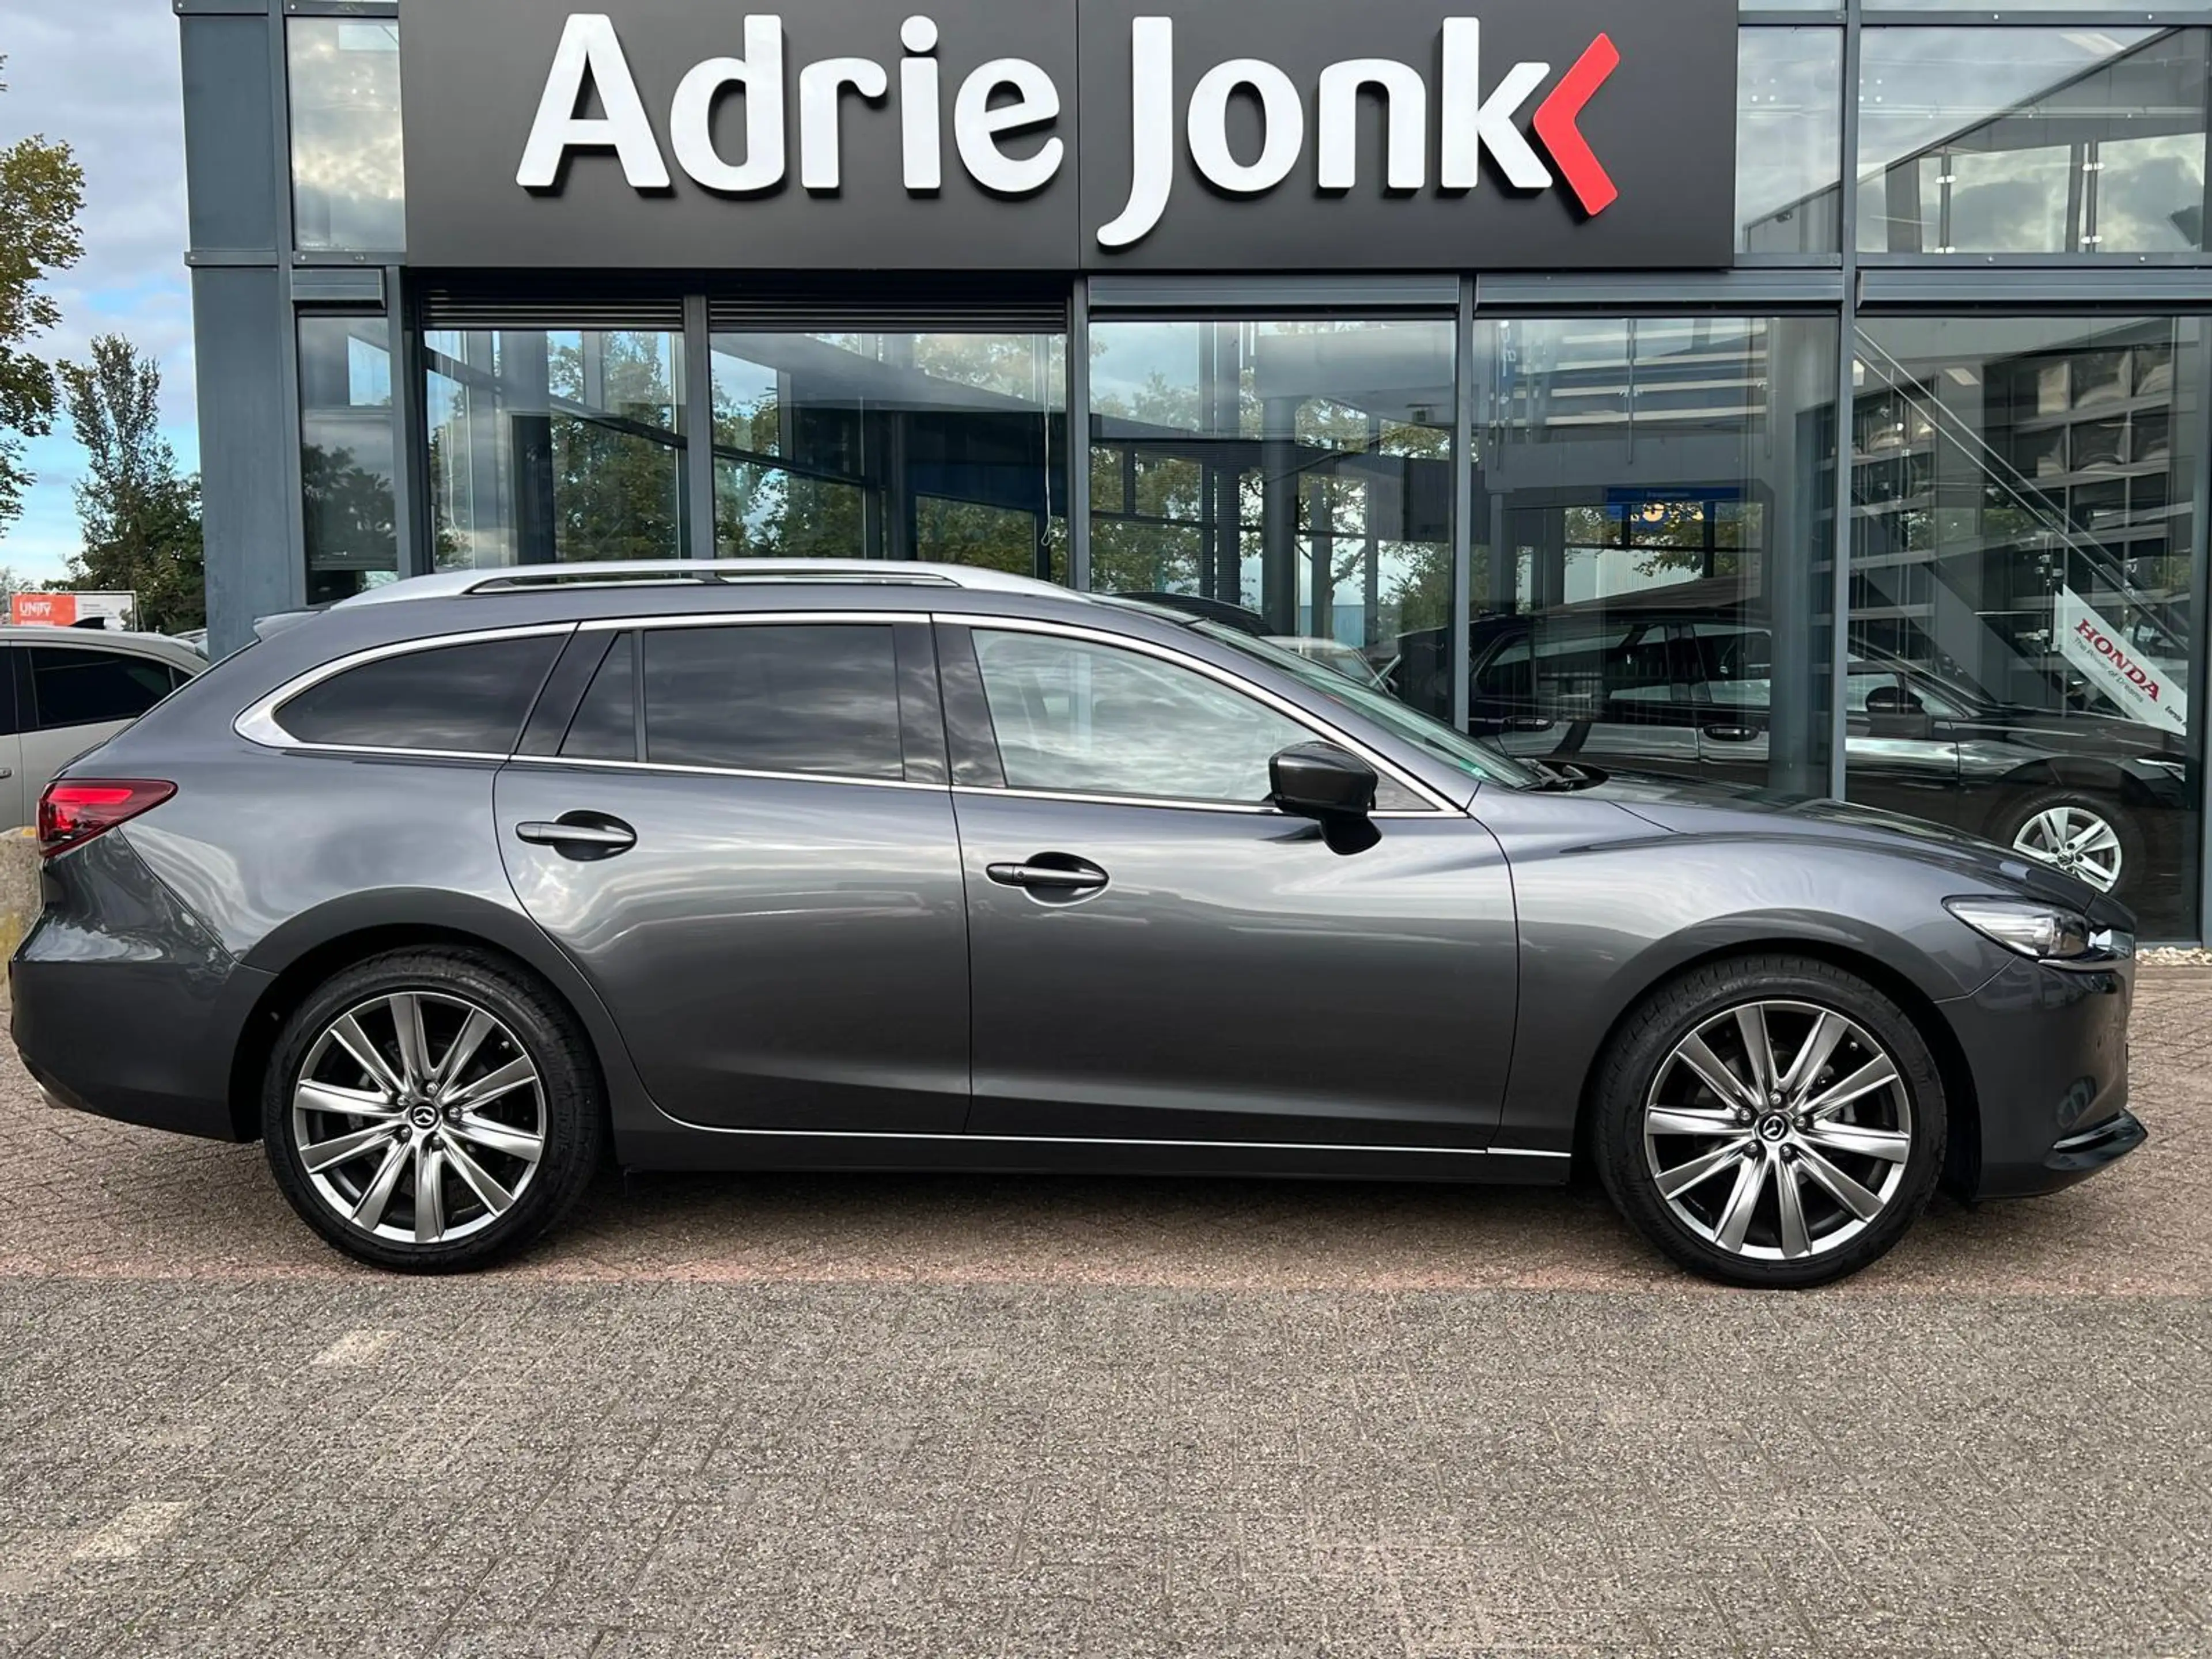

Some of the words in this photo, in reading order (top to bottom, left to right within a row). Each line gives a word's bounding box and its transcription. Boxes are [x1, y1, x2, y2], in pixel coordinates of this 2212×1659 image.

[516, 13, 1063, 191] Adrie
[1097, 17, 1553, 245] Jonk
[2074, 618, 2159, 702] HONDA
